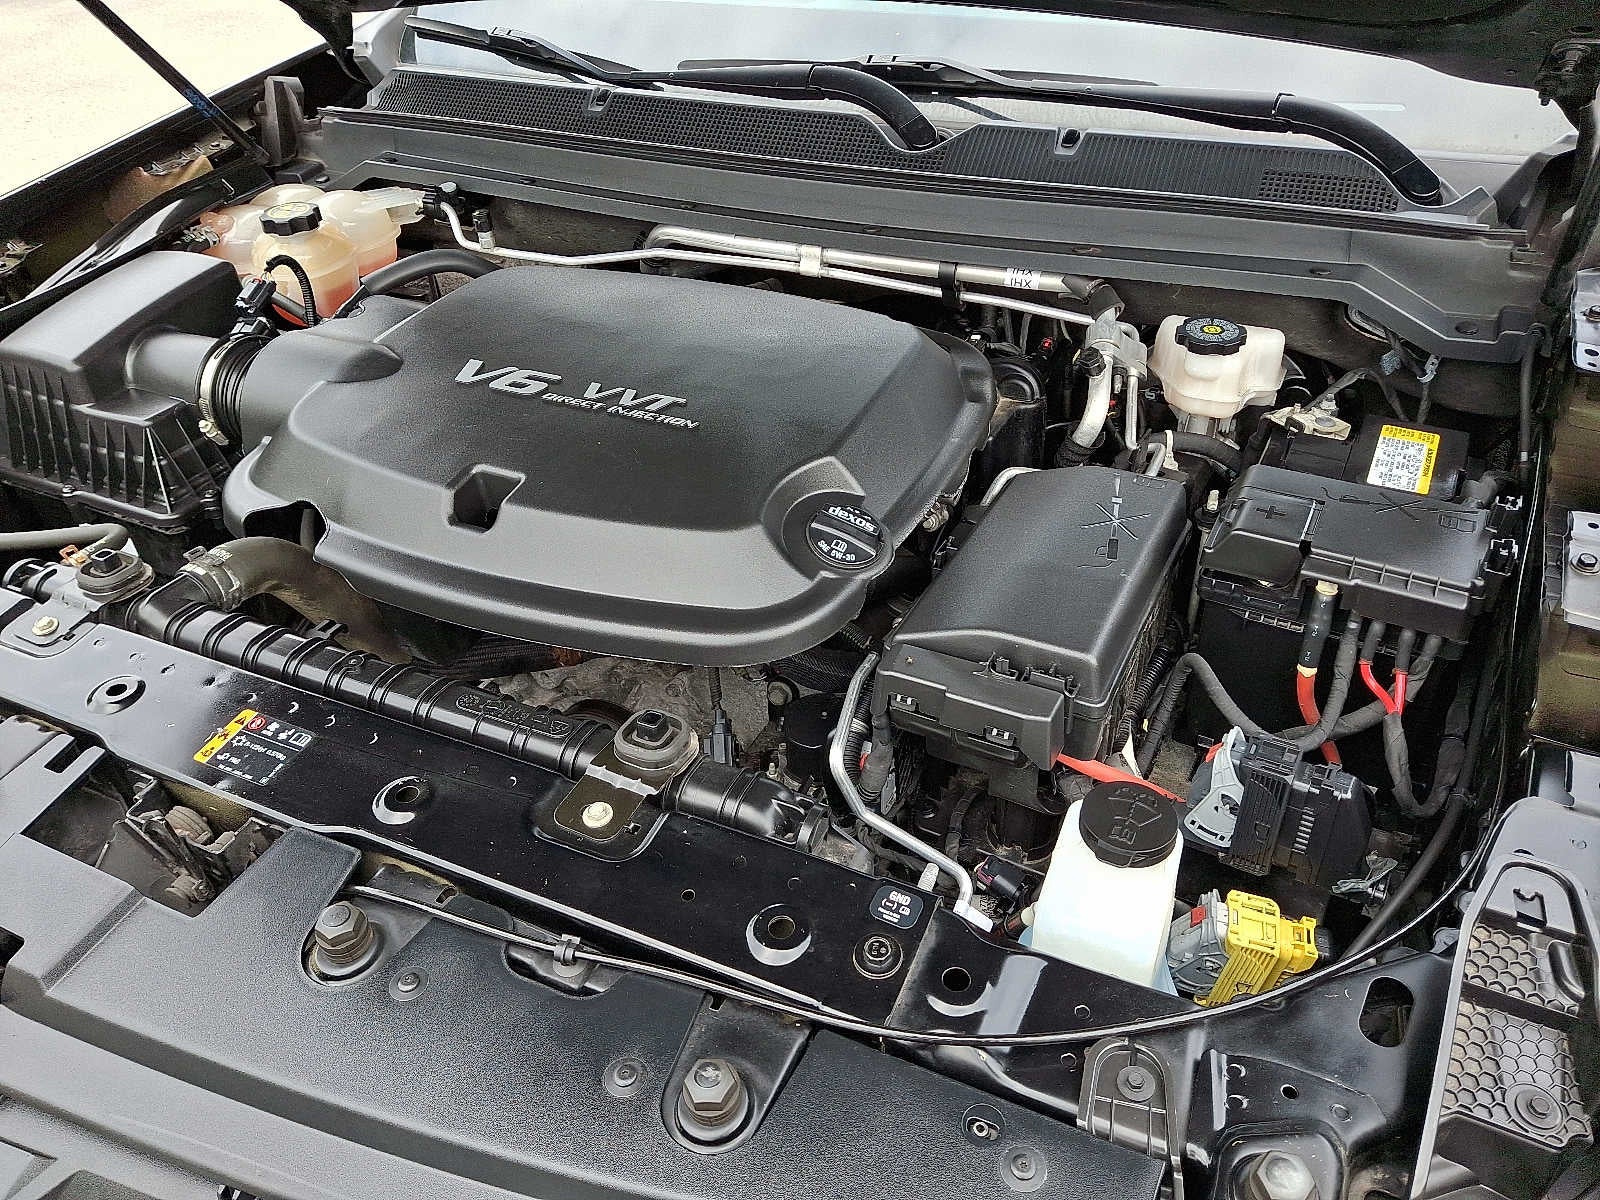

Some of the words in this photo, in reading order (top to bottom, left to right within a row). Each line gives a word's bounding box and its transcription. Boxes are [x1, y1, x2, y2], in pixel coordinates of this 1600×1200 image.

[455, 359, 562, 394] V6
[584, 382, 687, 411] VVT
[541, 393, 606, 410] DIRECT
[606, 405, 699, 429] INJECTION
[828, 506, 877, 532] dexos
[888, 890, 911, 906] GND
